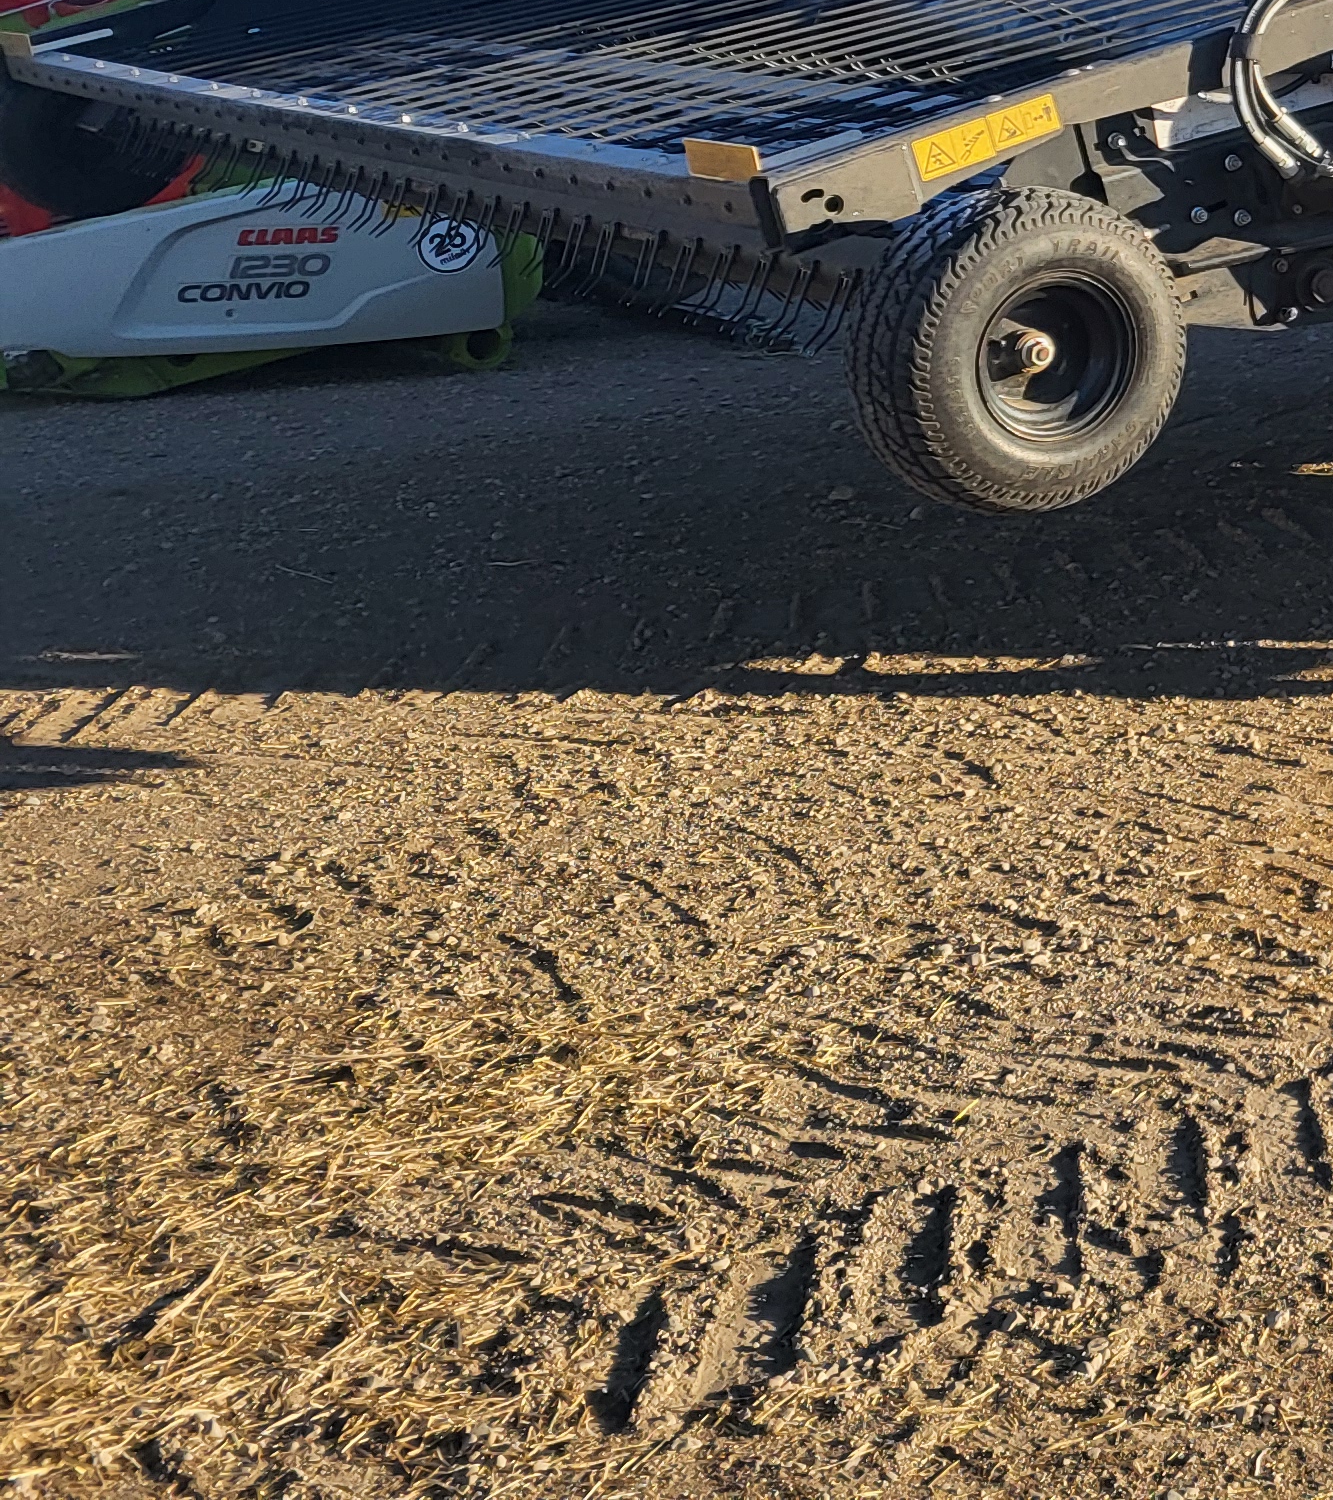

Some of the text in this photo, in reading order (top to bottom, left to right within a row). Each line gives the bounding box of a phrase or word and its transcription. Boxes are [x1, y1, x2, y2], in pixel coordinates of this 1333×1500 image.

[237, 226, 340, 247] CLAAS
[229, 253, 332, 279] 1230
[176, 280, 310, 304] CONVIO
